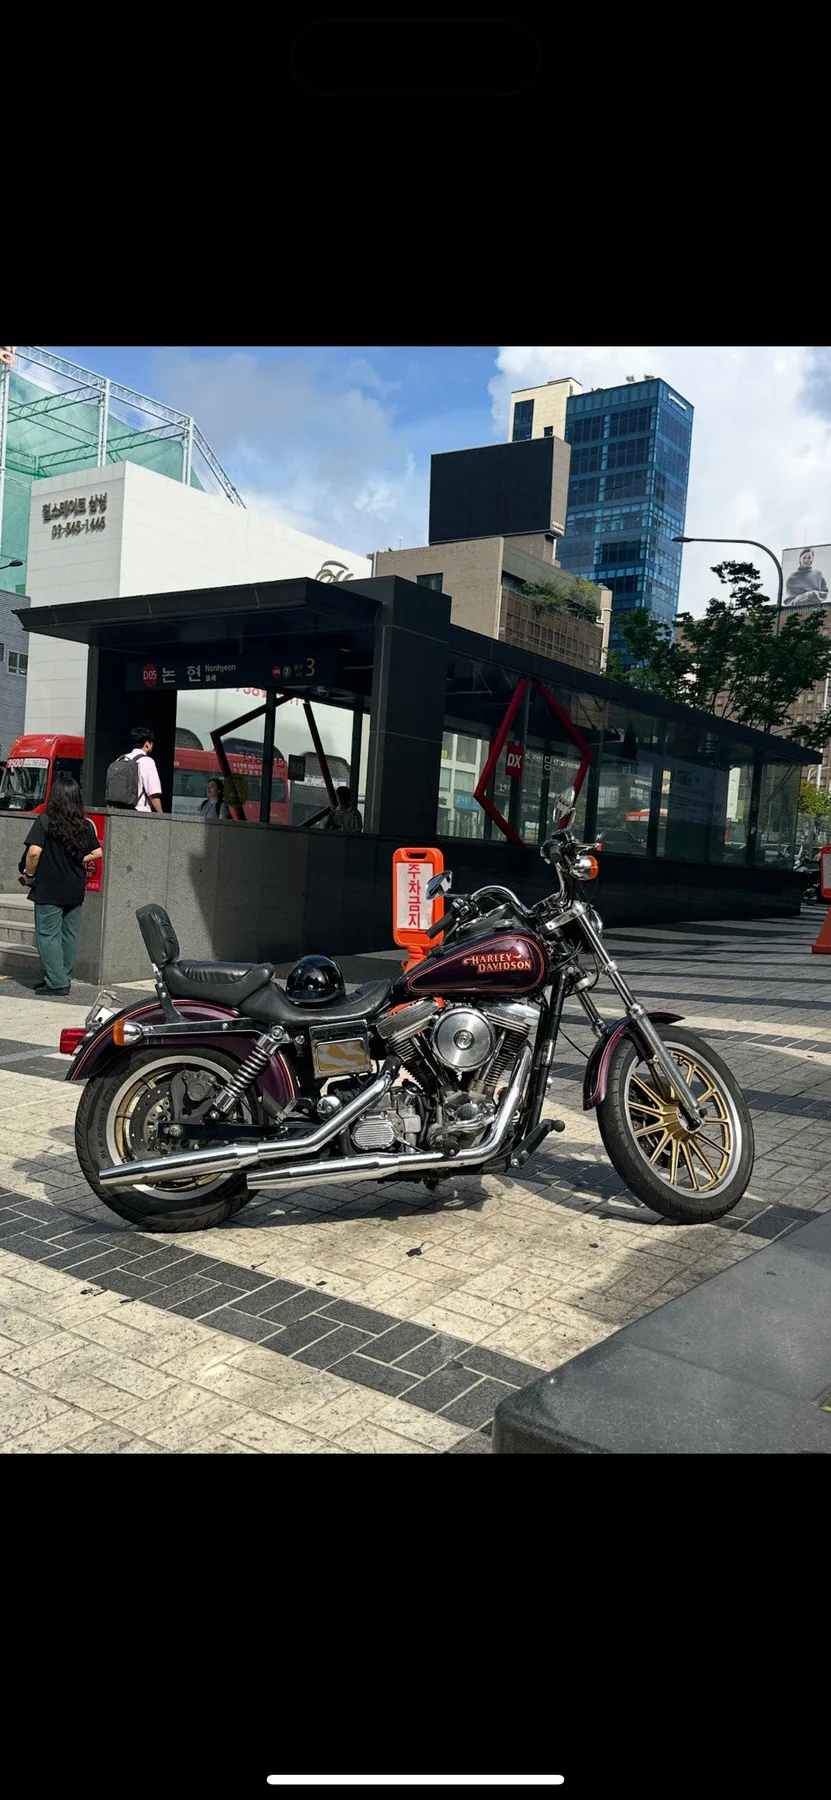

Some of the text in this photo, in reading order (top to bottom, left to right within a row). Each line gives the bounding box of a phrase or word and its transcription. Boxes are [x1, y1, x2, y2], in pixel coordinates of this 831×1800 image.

[205, 664, 236, 673] Nonhyeon
[306, 657, 315, 677] 3
[143, 670, 157, 680] D05
[506, 753, 522, 769] DX
[407, 863, 421, 928] 주차금지
[478, 961, 531, 972] DAVIDSON
